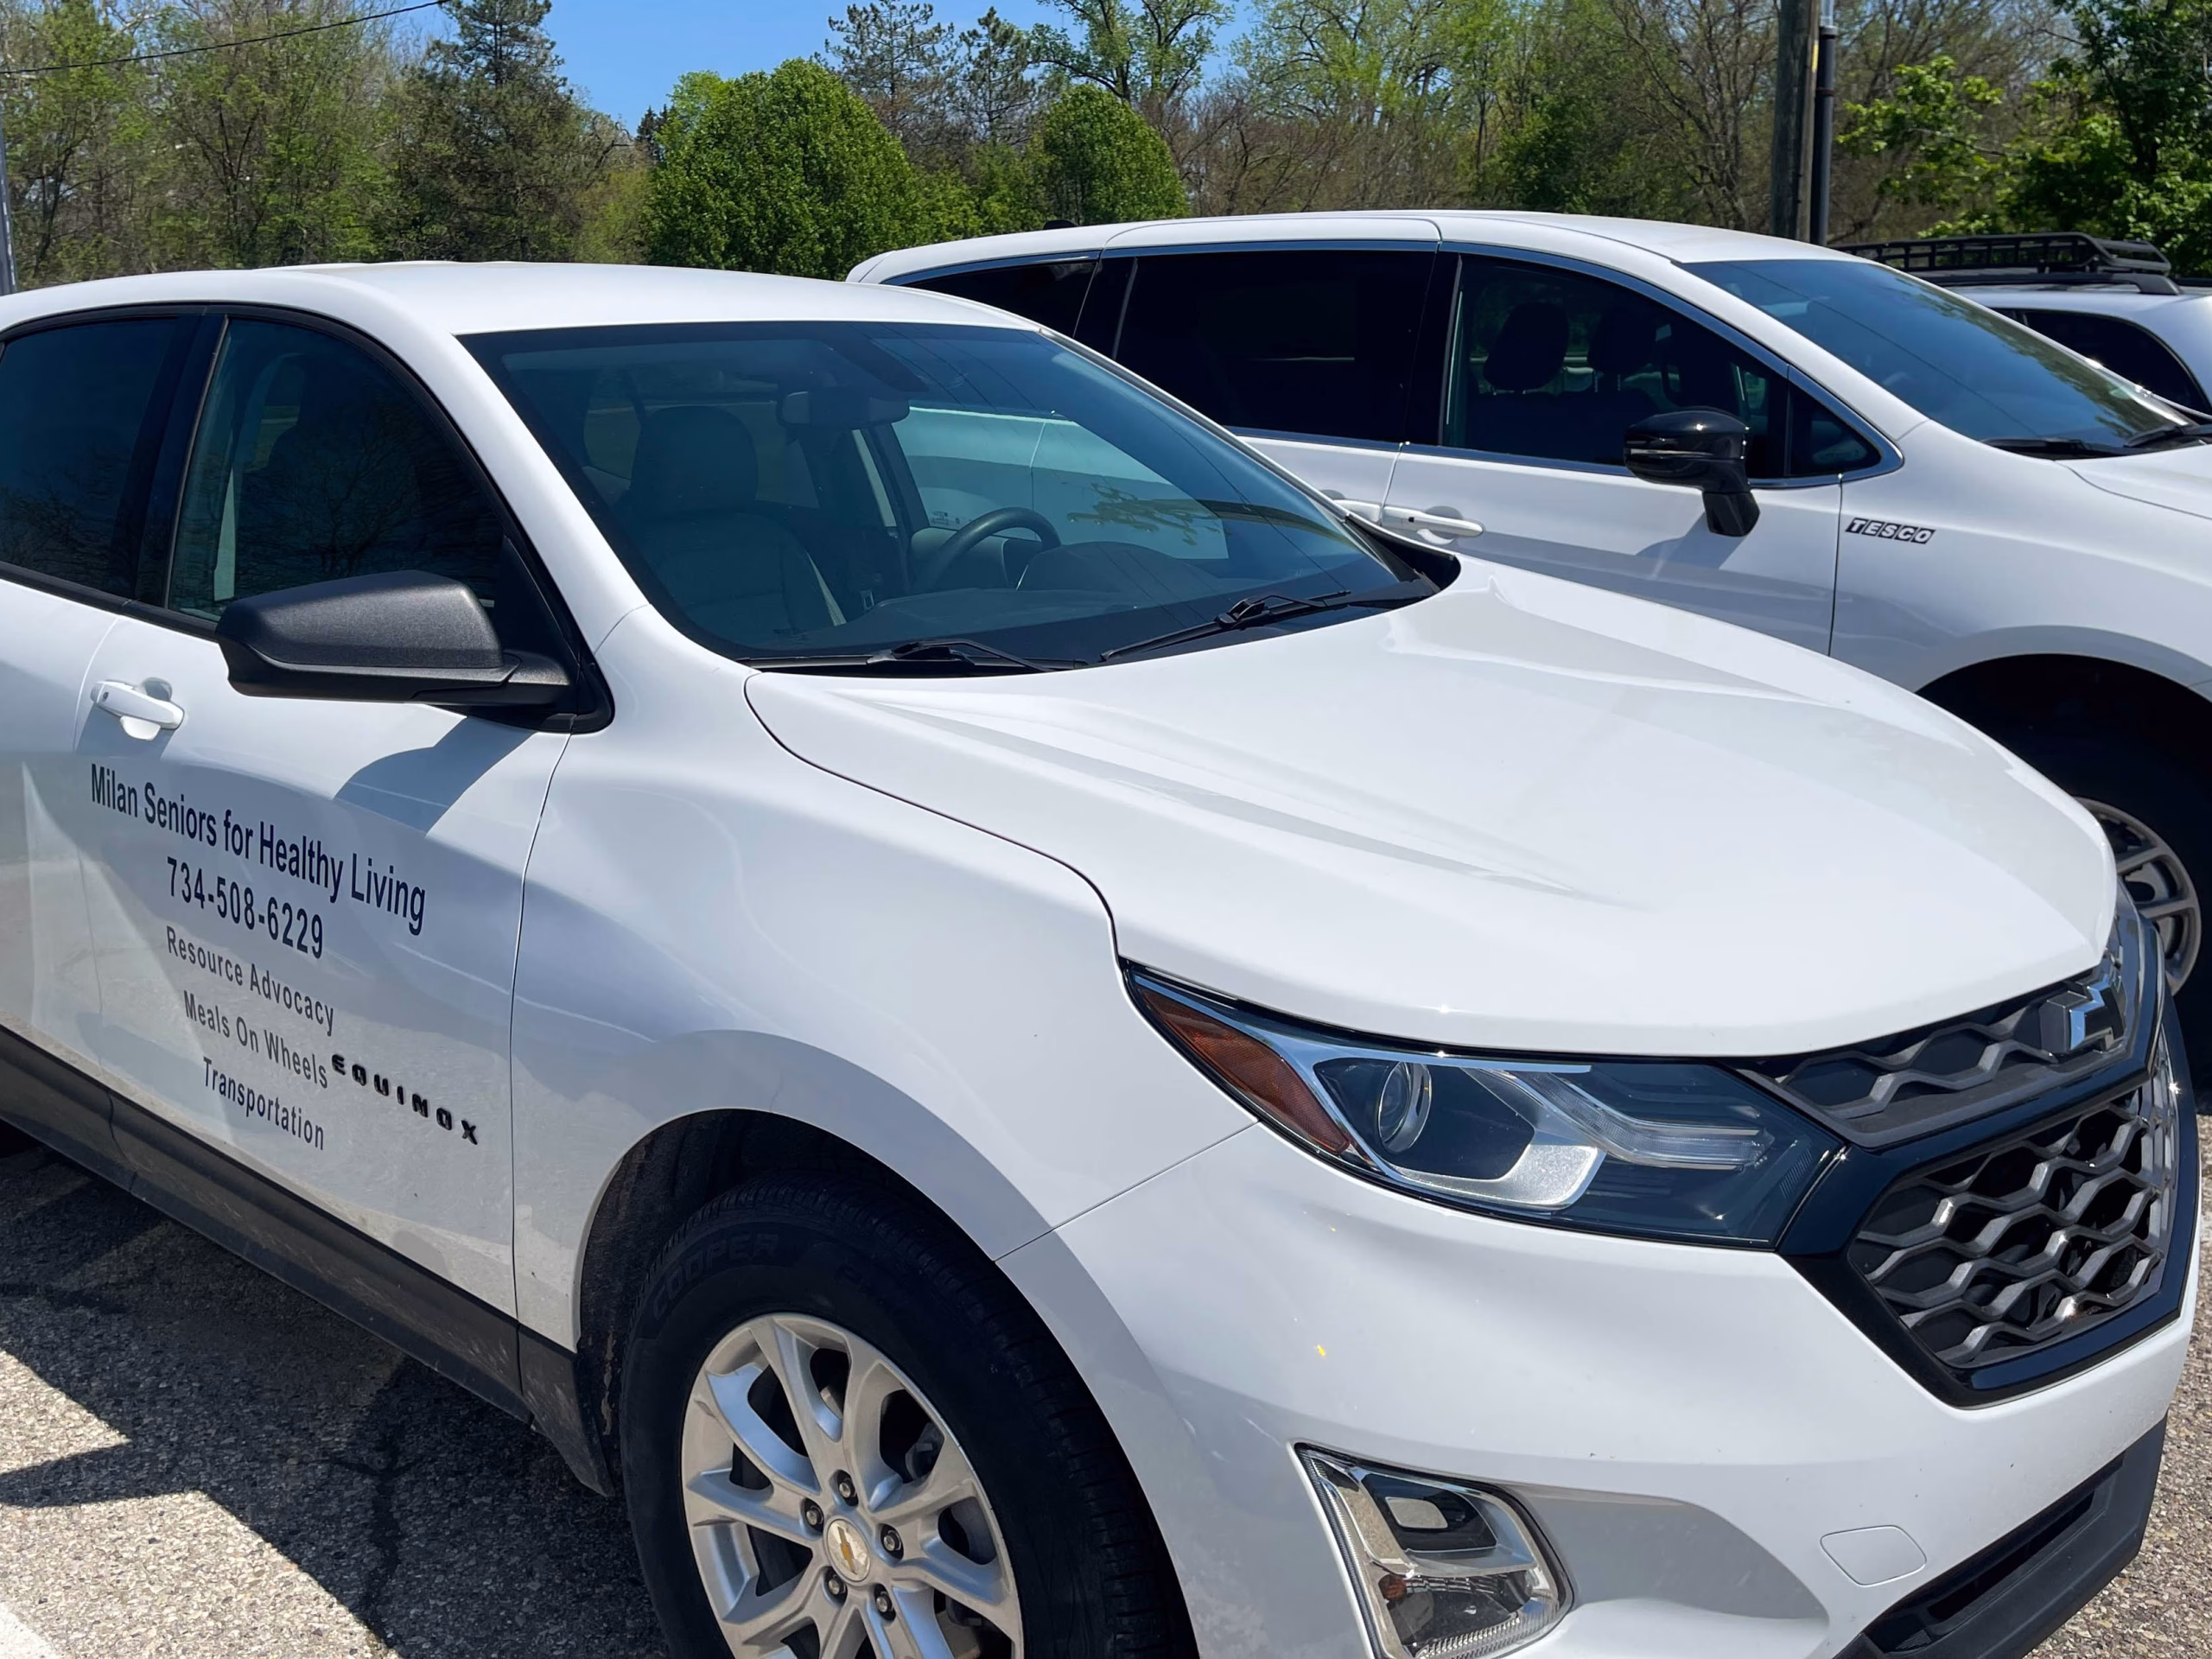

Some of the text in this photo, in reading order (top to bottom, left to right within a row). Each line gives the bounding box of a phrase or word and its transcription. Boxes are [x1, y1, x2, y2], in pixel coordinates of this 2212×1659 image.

[1846, 518, 1936, 544] TESCO
[90, 763, 426, 937] Milan Seniors for Healthy Living
[167, 856, 323, 959] 734-508-6229
[167, 925, 334, 1037] Resource Advocacy
[183, 989, 328, 1090] Meals On Wheels
[203, 1056, 325, 1151] Transportation
[331, 1053, 478, 1146] EQUINOX
[654, 1233, 779, 1320] COOPER
